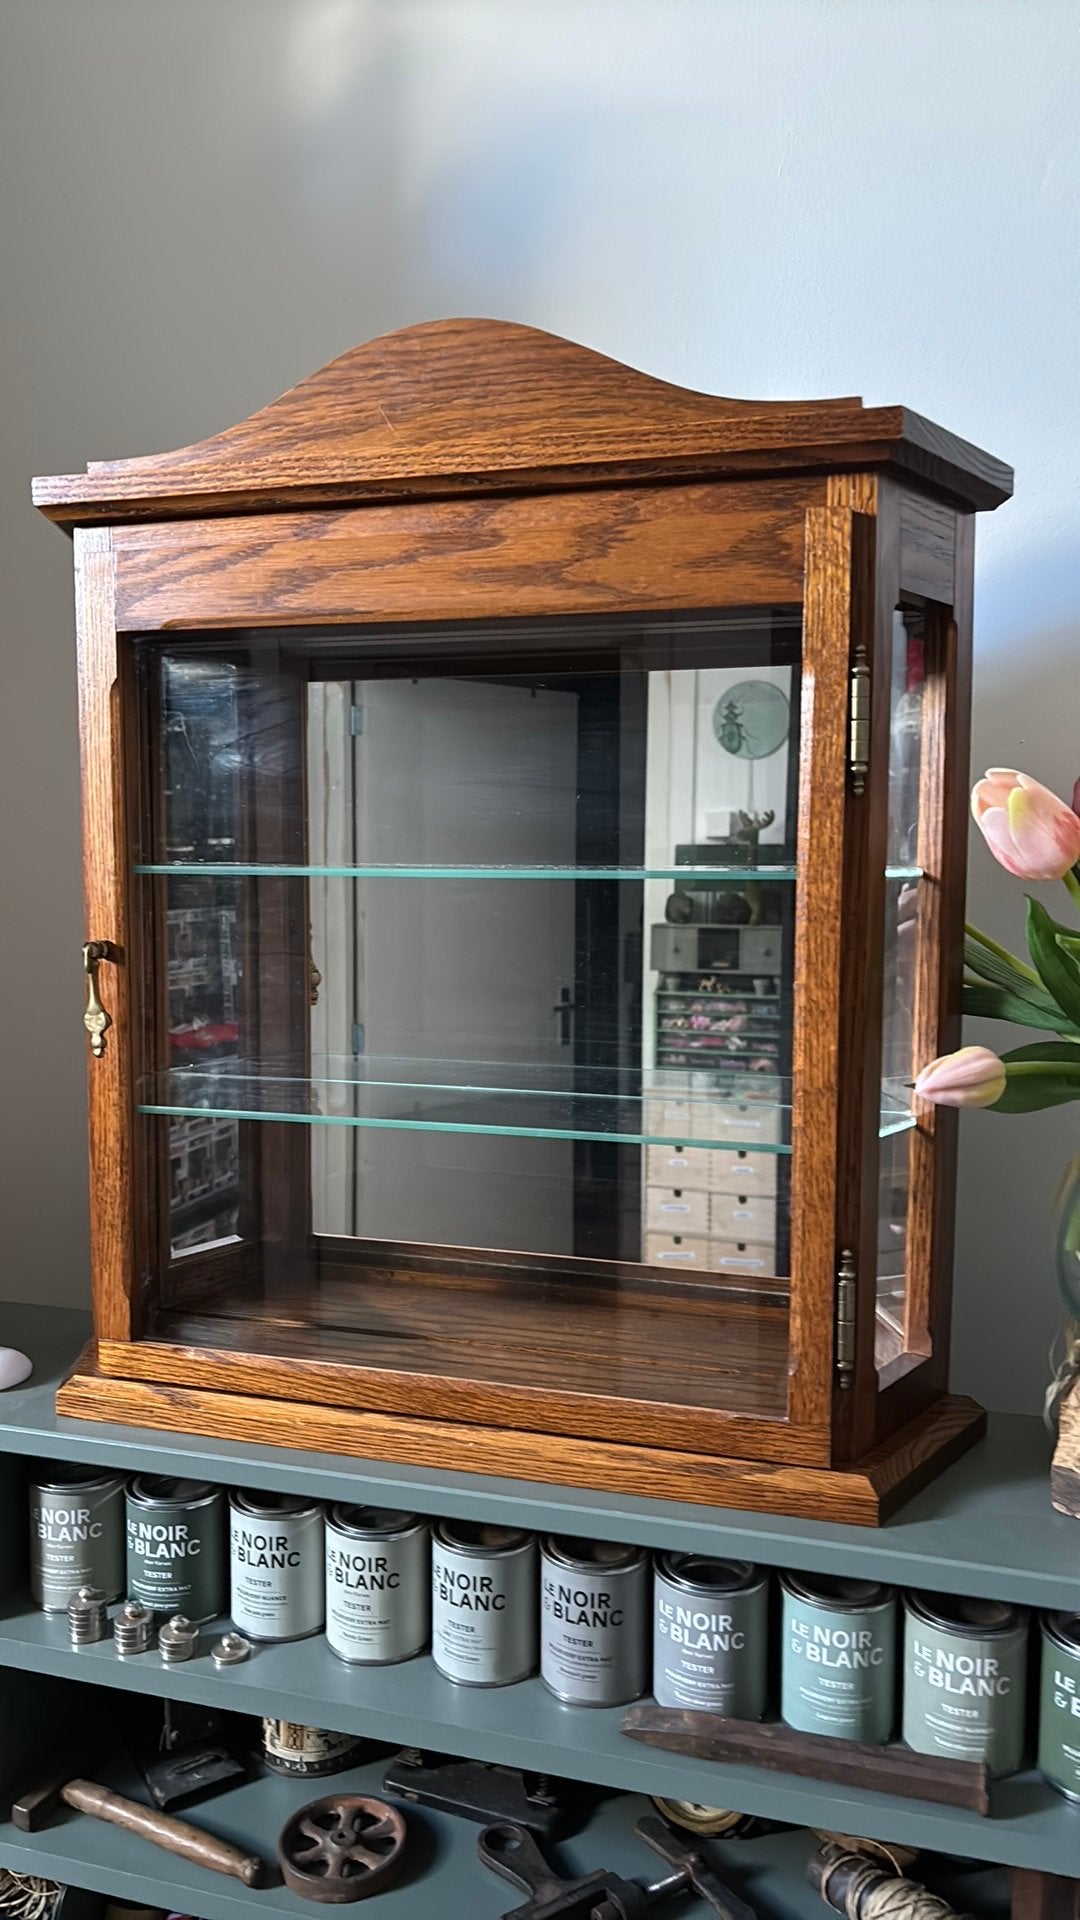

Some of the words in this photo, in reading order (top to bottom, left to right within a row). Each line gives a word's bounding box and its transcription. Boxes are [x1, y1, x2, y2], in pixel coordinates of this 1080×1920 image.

[41, 1507, 91, 1525] NOIR
[38, 1522, 102, 1542] BLANC
[127, 1518, 138, 1535] LE
[138, 1522, 189, 1542] NOIR
[242, 1530, 289, 1552] NOIR
[134, 1537, 201, 1559] BLANC
[238, 1546, 301, 1569] BLANC
[339, 1551, 388, 1573] NOIR
[143, 1569, 173, 1579] TESTER
[244, 1576, 273, 1588] TESTER
[335, 1566, 401, 1591] BLANC
[443, 1567, 493, 1593] NOIR
[343, 1599, 372, 1612] TESTER
[439, 1582, 507, 1611] BLANC
[558, 1585, 611, 1609] NOIR
[553, 1601, 625, 1628] BLANC
[659, 1599, 674, 1620] LE
[676, 1606, 734, 1632] NOIR
[447, 1619, 476, 1634] TESTER
[659, 1618, 669, 1634] &
[670, 1622, 746, 1652] BLANC
[791, 1618, 809, 1639] LE
[813, 1625, 873, 1649] NOIR
[562, 1634, 594, 1648] TESTER
[791, 1637, 803, 1654] &
[806, 1641, 884, 1669] BLANC
[914, 1640, 932, 1663] LE
[936, 1648, 999, 1677] NOIR
[680, 1659, 716, 1674] TESTER
[817, 1677, 856, 1691] TESTER
[913, 1661, 926, 1677] &
[928, 1665, 1011, 1697] BLANC
[1054, 1670, 1076, 1694] LE
[941, 1702, 979, 1719] TESTER
[1054, 1691, 1068, 1708] &
